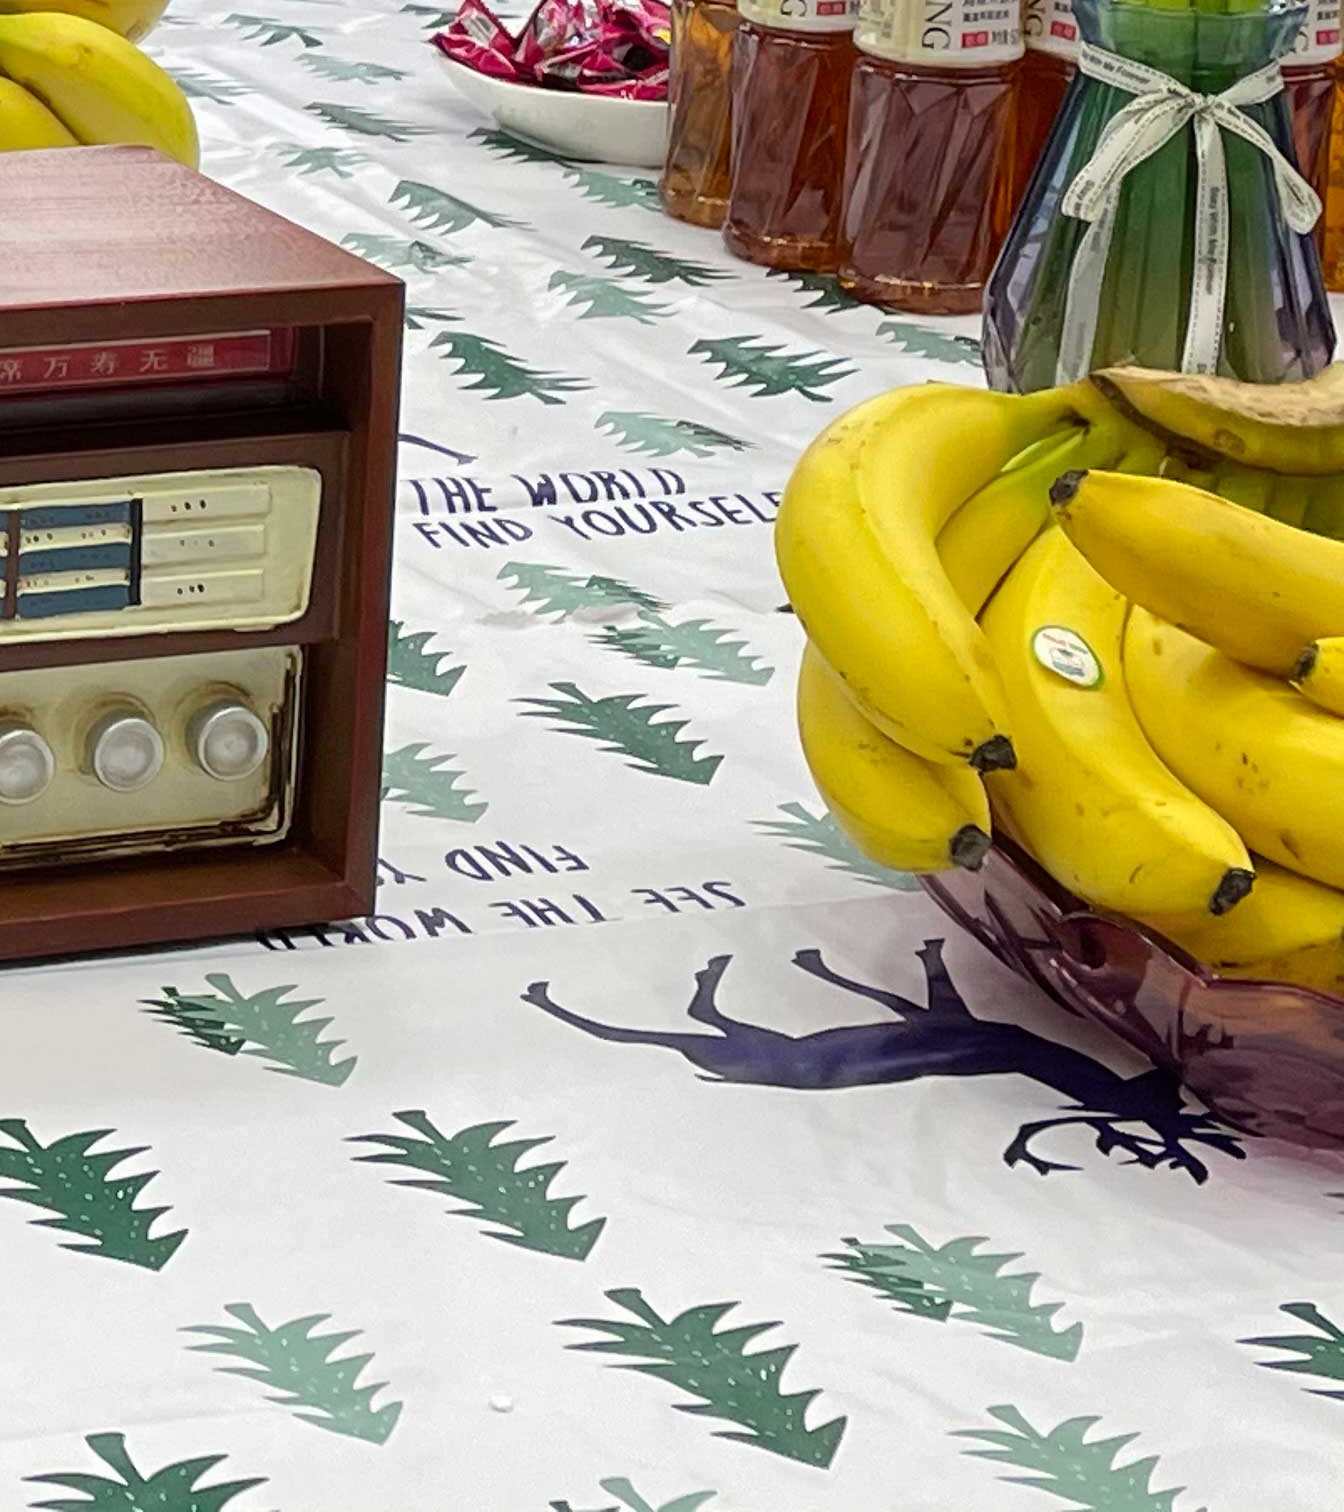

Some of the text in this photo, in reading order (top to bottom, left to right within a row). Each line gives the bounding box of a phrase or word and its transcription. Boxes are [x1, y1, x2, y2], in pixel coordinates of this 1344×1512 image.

[411, 476, 499, 517] THE
[414, 490, 783, 549] FIND YOURSELF
[444, 840, 591, 883] FIND
[486, 894, 609, 928] THE
